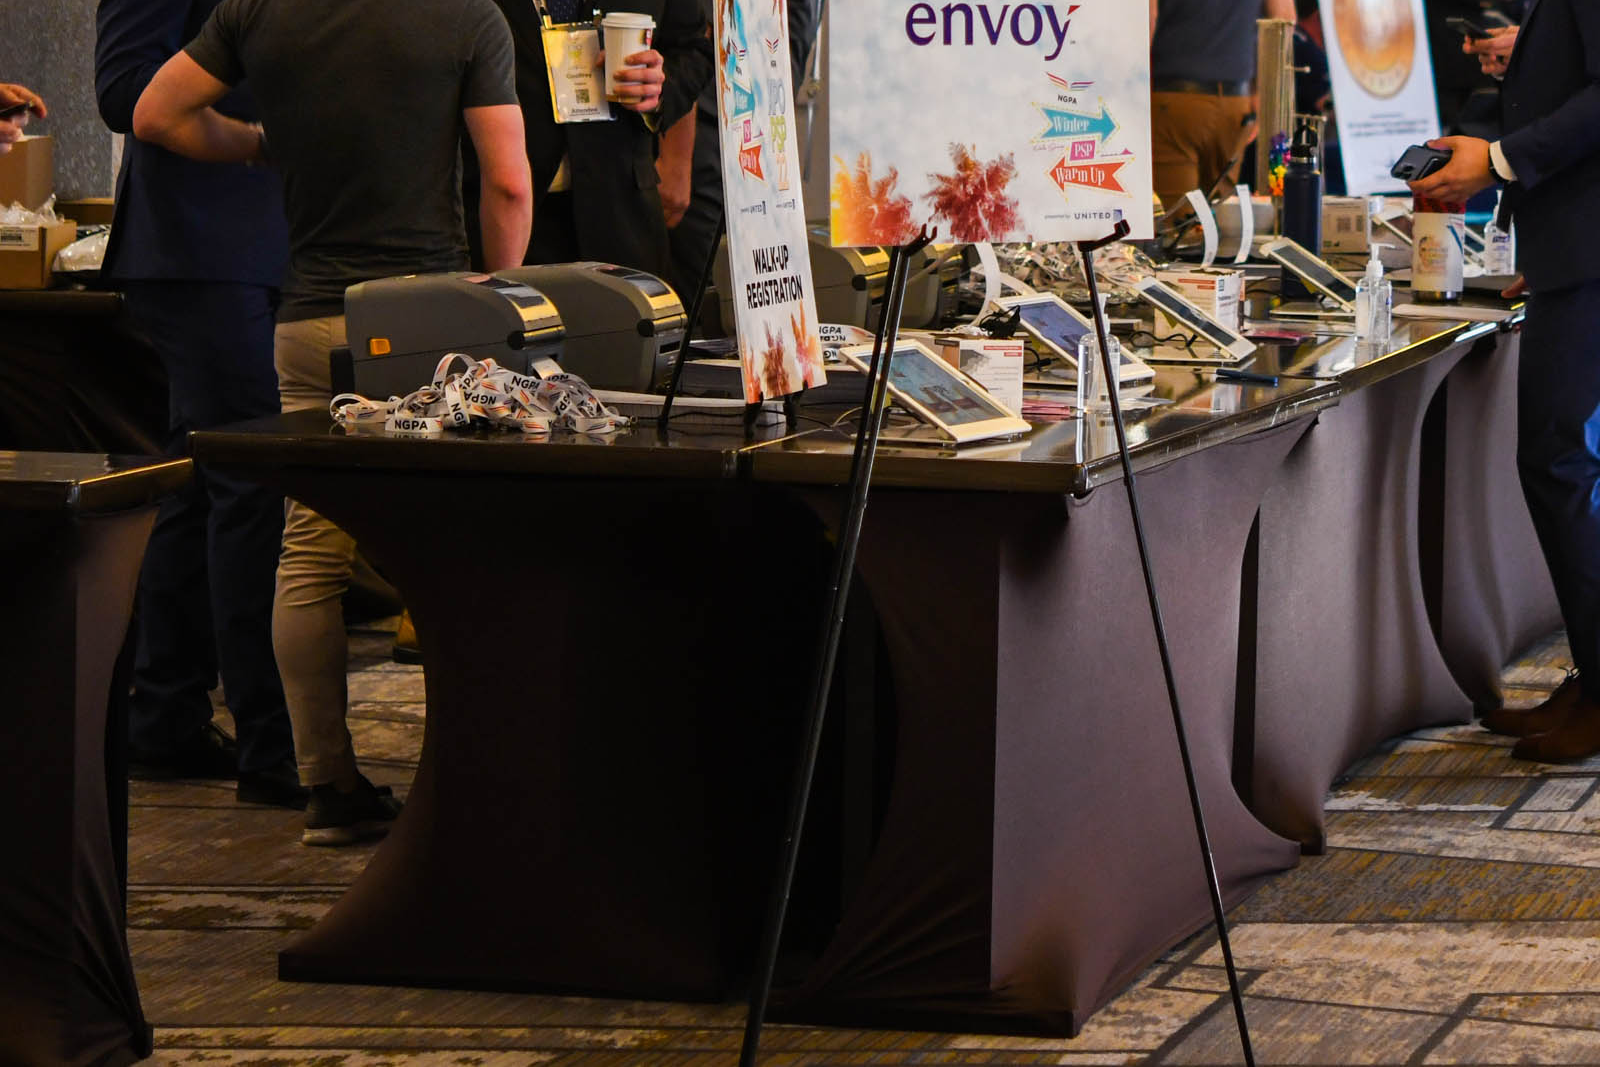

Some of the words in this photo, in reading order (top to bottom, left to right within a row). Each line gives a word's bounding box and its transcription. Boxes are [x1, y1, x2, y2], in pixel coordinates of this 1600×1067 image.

[905, 2, 1081, 62] envoy
[1057, 94, 1078, 105] NGPA
[1053, 116, 1090, 133] Winter
[1074, 142, 1093, 158] PSP
[1055, 166, 1088, 184] Warm
[1090, 167, 1105, 185] Up
[1074, 212, 1111, 220] UNITED
[752, 245, 789, 275] WALK-UP
[746, 275, 803, 309] REGISTRATION
[464, 391, 496, 405] NGPA
[394, 420, 428, 431] NGPA
